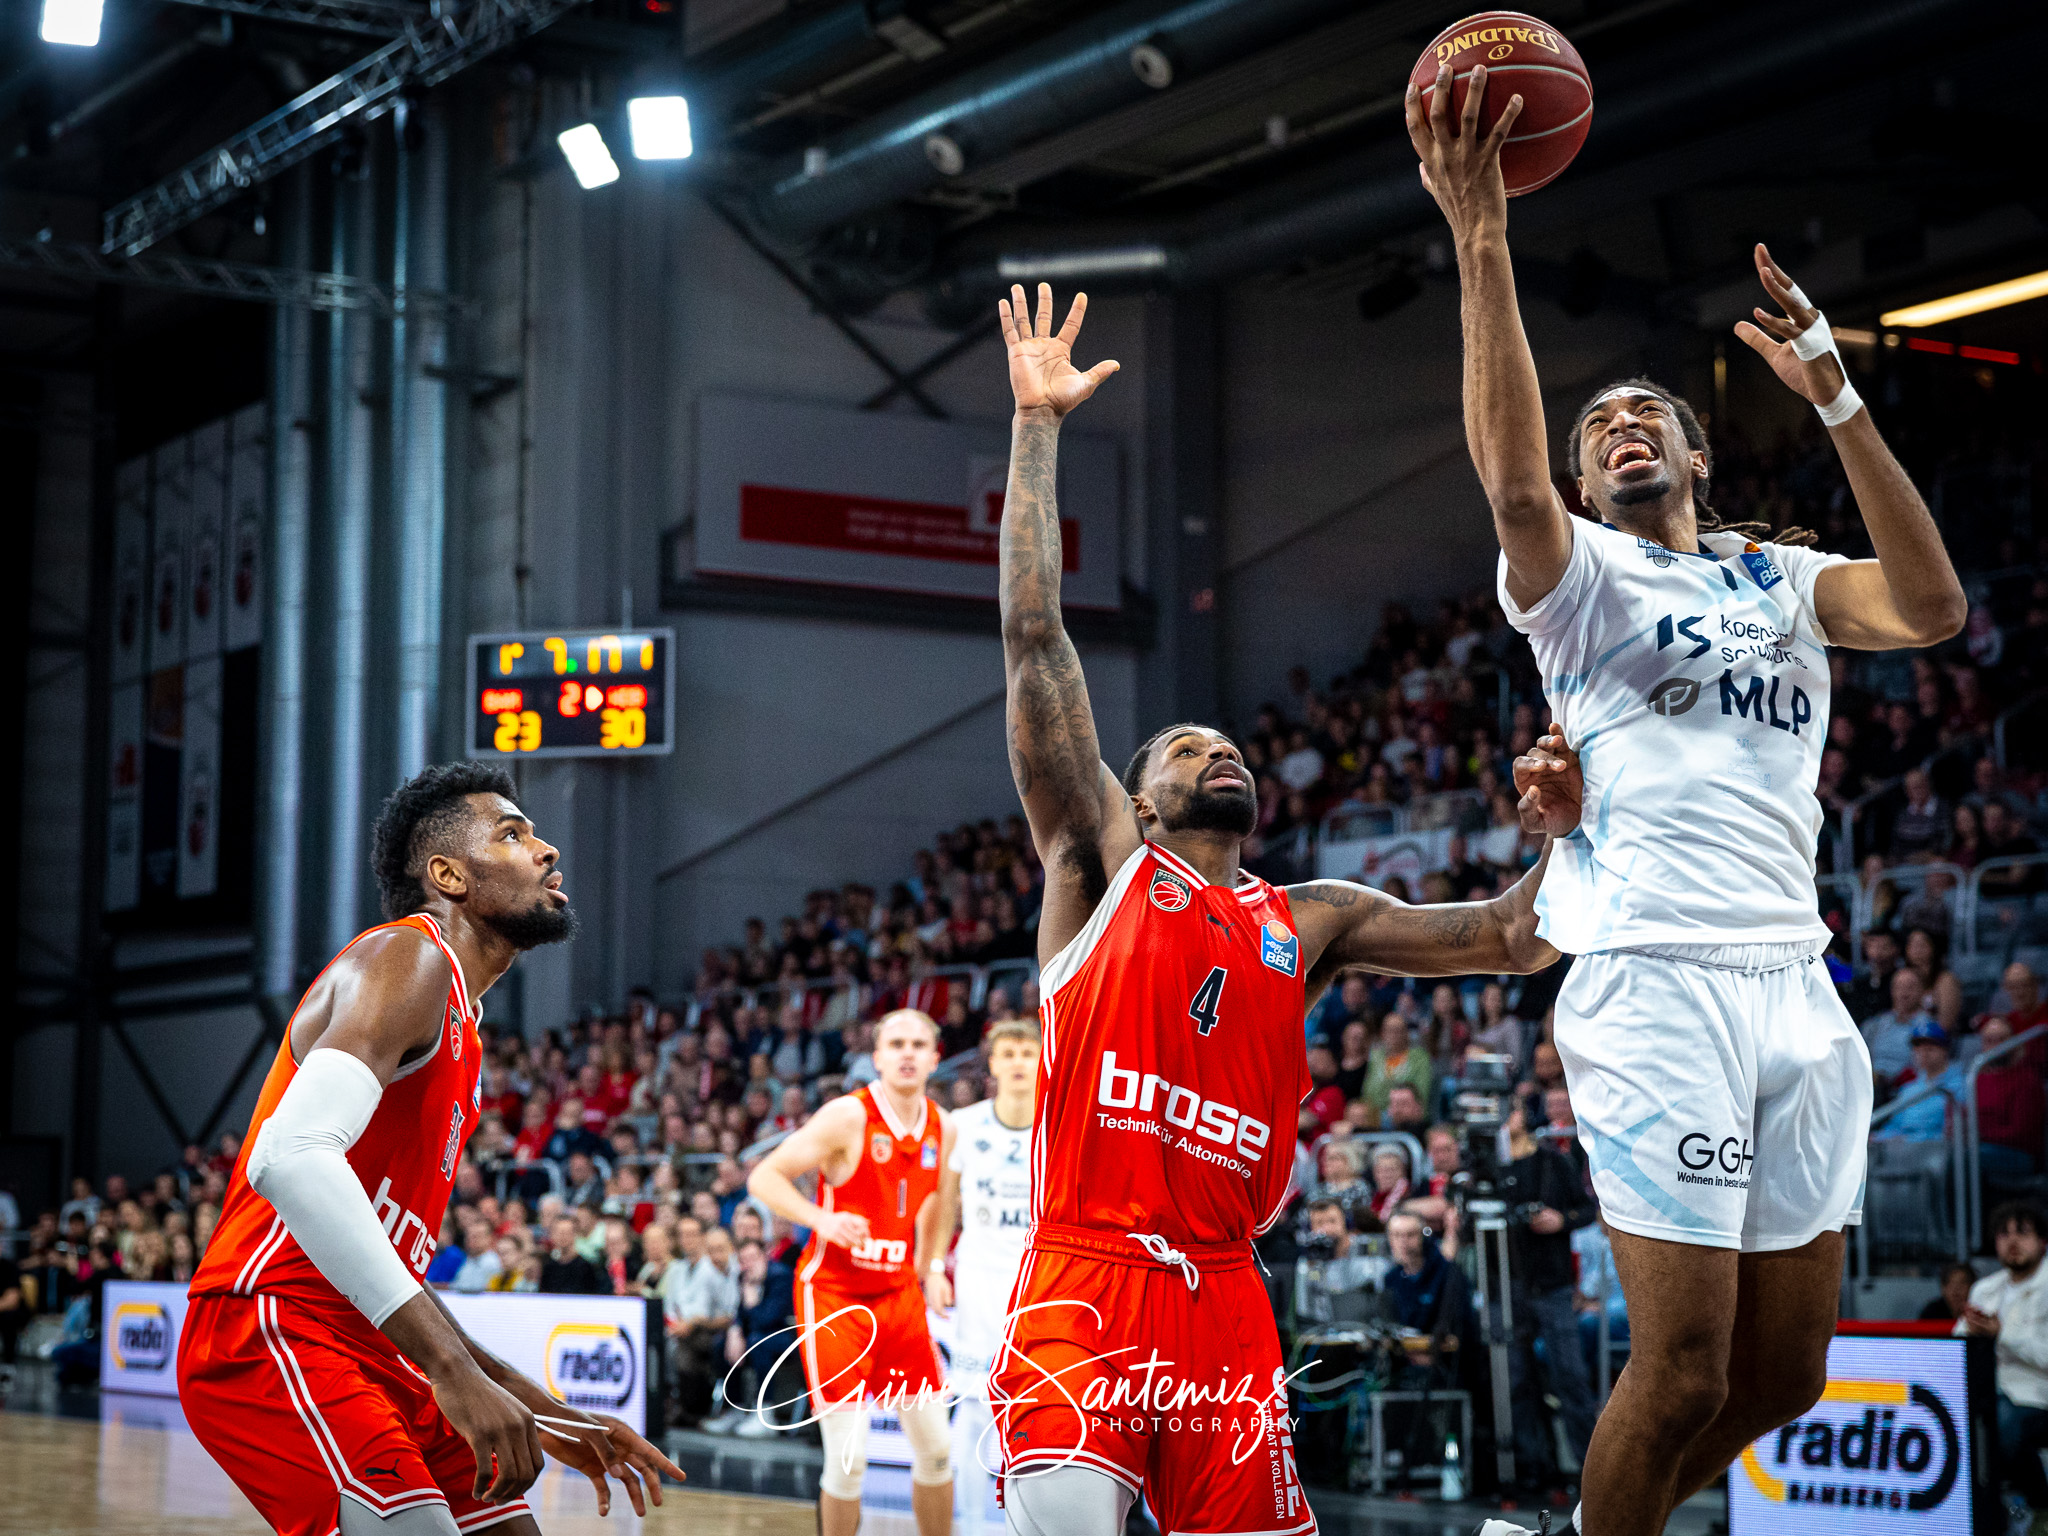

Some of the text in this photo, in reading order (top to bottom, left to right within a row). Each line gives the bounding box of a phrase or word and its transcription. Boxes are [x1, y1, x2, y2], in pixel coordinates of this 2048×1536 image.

[1435, 27, 1560, 67] SPALDING
[558, 681, 583, 718] 2
[1719, 669, 1811, 736] MLP
[494, 711, 542, 752] 23
[600, 707, 646, 749] 30
[1265, 951, 1292, 971] BBL
[1188, 966, 1228, 1037] 4
[1096, 1113, 1161, 1136] Technik
[1098, 1050, 1271, 1162] brose
[1677, 1171, 1713, 1186] Wohnen
[1715, 1176, 1723, 1187] in
[560, 1343, 625, 1384] radio
[1269, 1450, 1278, 1458] &
[1776, 1409, 1931, 1473] radio
[1271, 1460, 1285, 1519] KOLLEGEN
